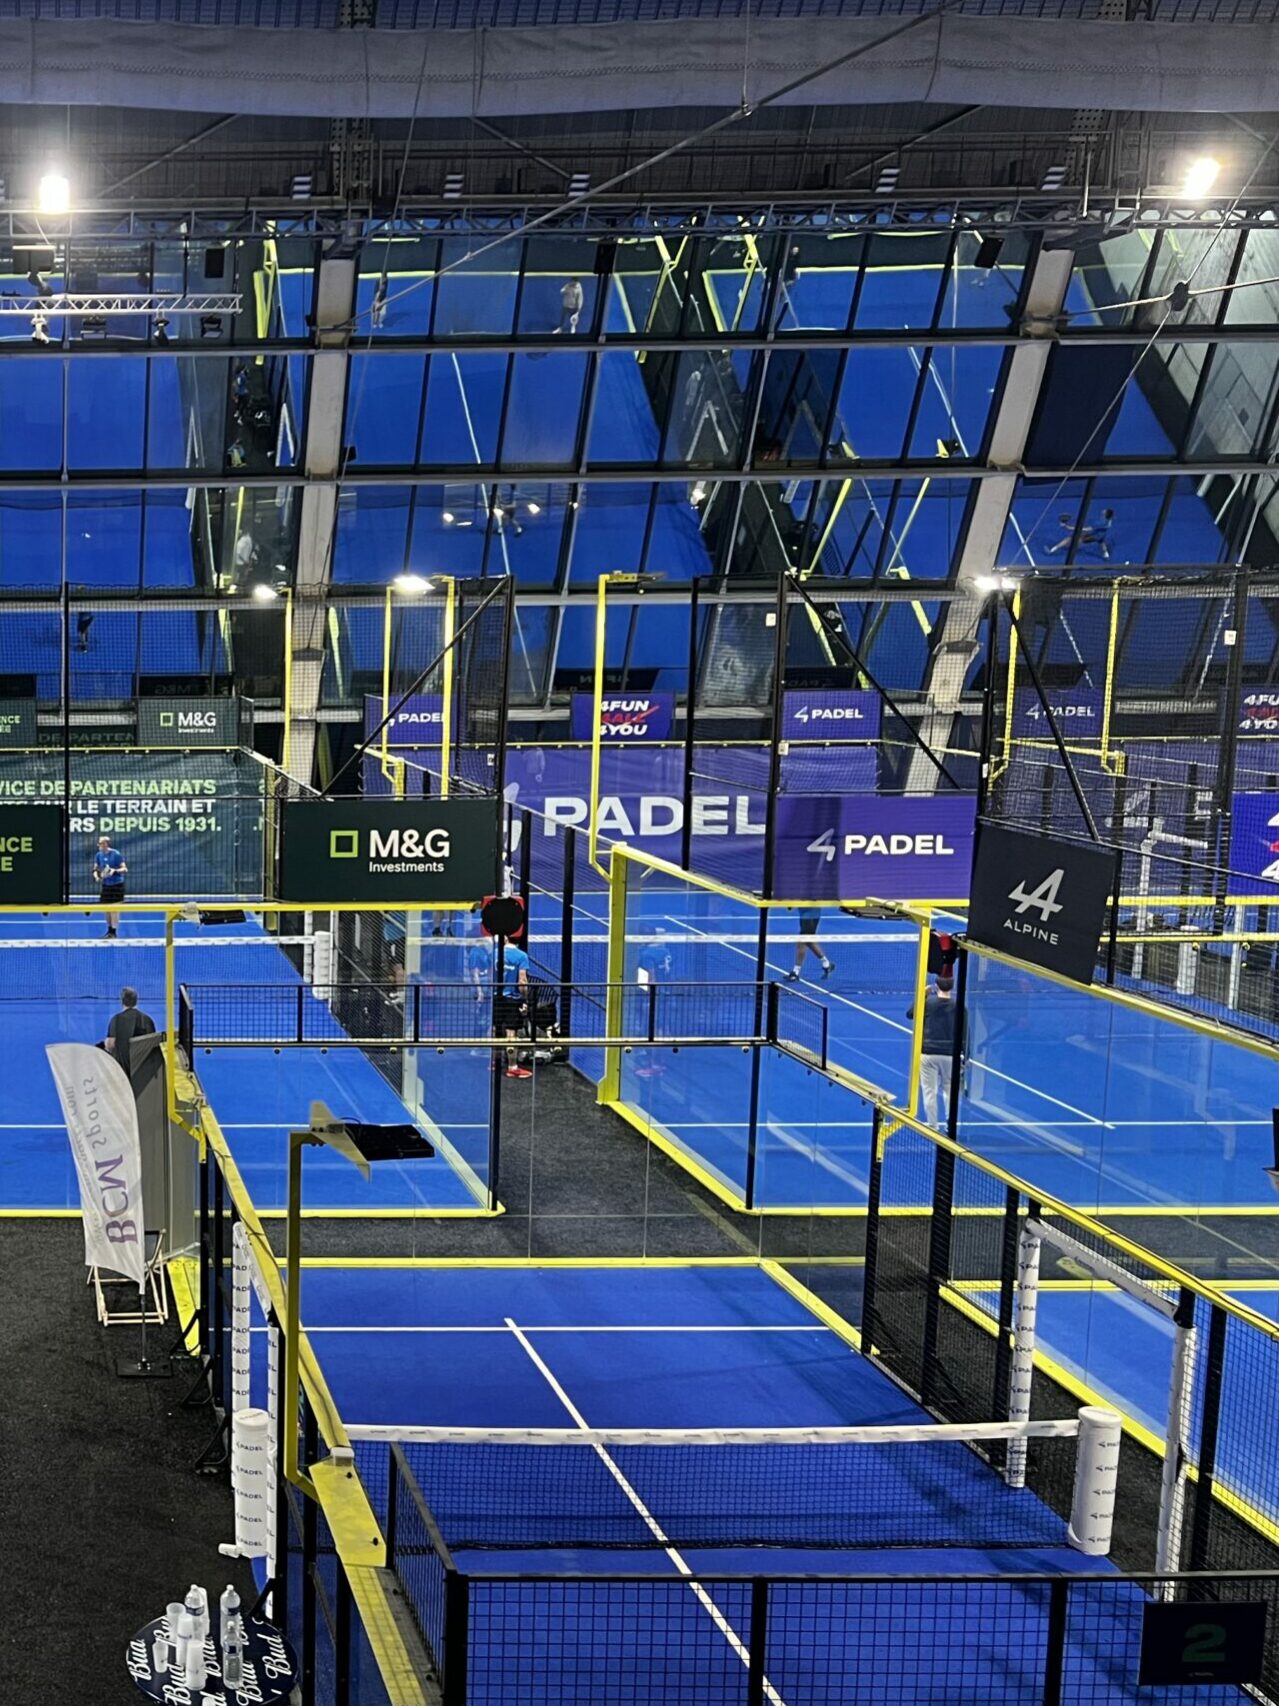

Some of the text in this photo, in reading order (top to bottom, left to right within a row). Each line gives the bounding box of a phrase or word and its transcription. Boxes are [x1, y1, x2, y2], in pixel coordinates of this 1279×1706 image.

[1244, 695, 1279, 705] 4FU
[178, 712, 216, 726] M&G
[398, 713, 444, 723] PADE
[812, 709, 863, 719] PADEL
[1239, 719, 1279, 729] 4YO
[41, 780, 65, 796] DE
[70, 779, 216, 796] PARTENARIATS
[77, 799, 98, 814] LE
[104, 799, 186, 813] TERRAIN
[192, 799, 215, 812] ET
[100, 817, 170, 832] DEPUIS
[175, 817, 221, 831] 1931.
[544, 797, 767, 837] PADEL
[369, 829, 450, 858] M&G
[845, 835, 954, 855] PADEL
[369, 861, 445, 873] Investments
[1003, 919, 1059, 945] ALPINE
[1182, 1624, 1227, 1663] 2
[256, 1633, 293, 1679] Bud
